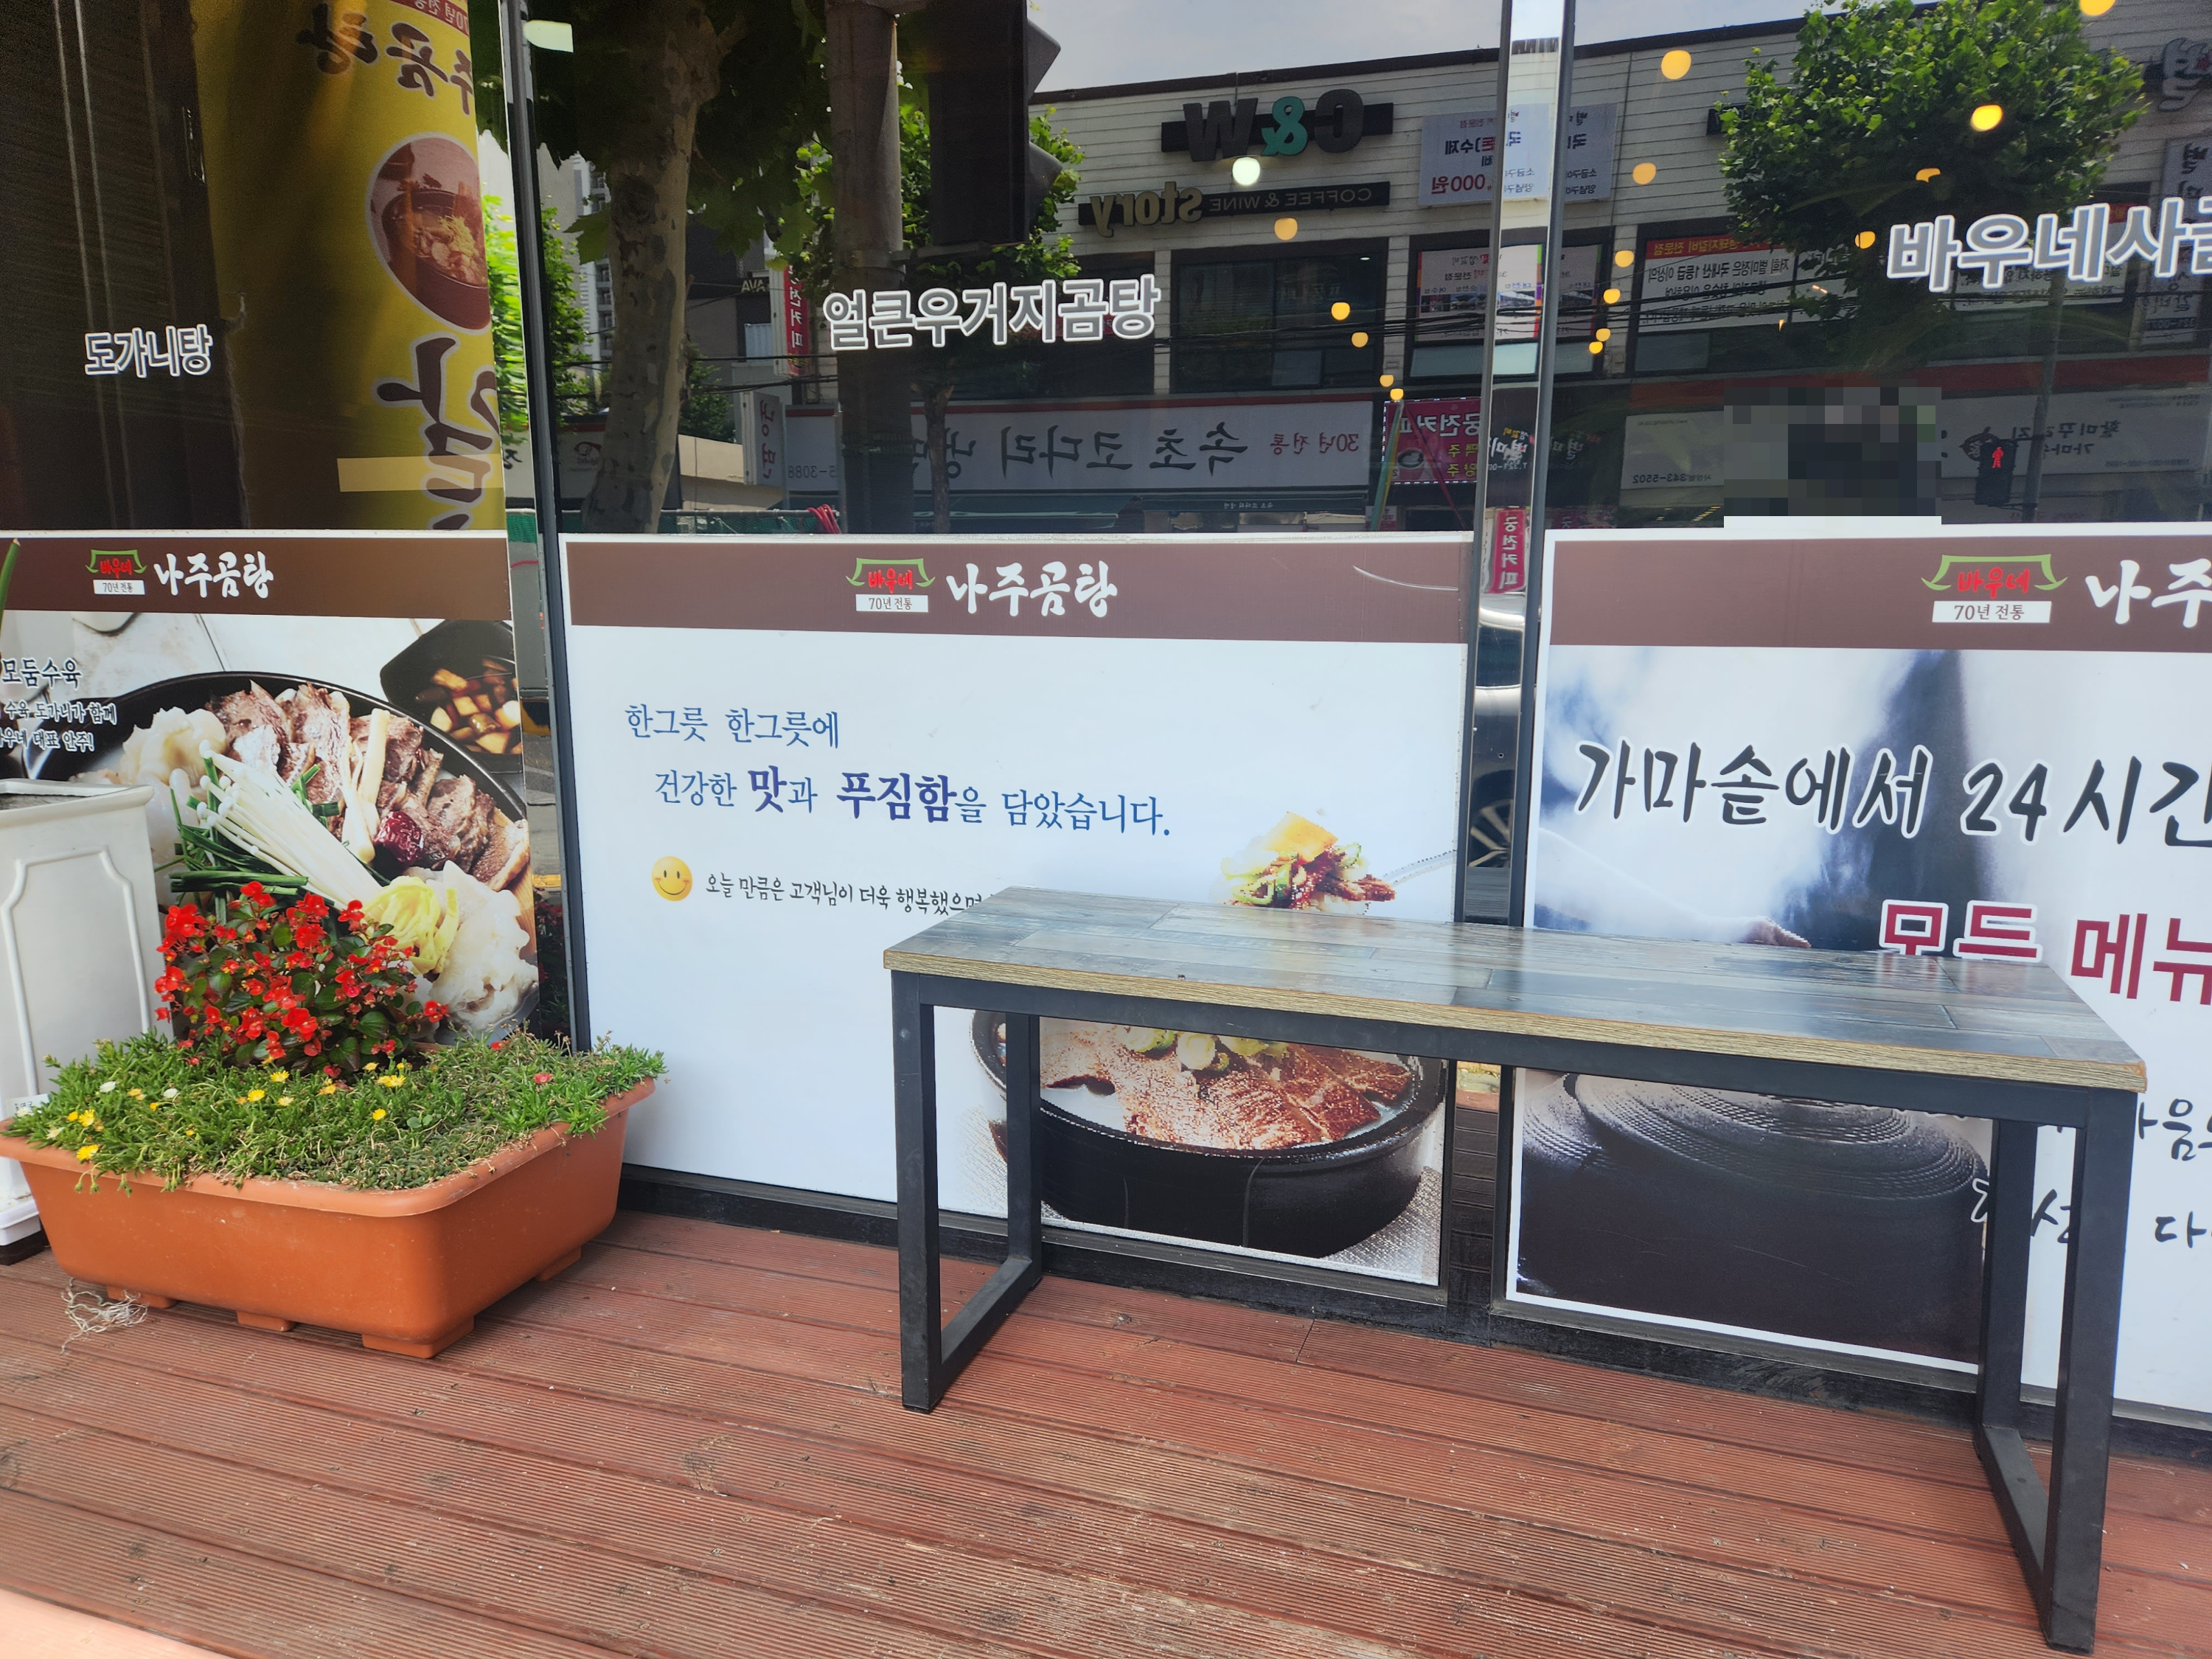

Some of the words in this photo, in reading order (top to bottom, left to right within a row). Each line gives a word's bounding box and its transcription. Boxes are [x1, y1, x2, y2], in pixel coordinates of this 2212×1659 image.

[822, 274, 1162, 352] 얼큰우거지곰탕
[84, 324, 213, 378] 도가니탕
[100, 557, 132, 579] 바우네
[153, 550, 274, 599] 나주곰탕
[867, 567, 914, 594] 바우네
[1958, 567, 2031, 599] 바우네
[102, 582, 119, 594] 70년
[868, 597, 893, 611] 70년
[894, 597, 914, 611] 전통
[945, 560, 1118, 618] 나주곰탕
[1954, 604, 1990, 620] 70년
[1994, 603, 2025, 620] 전통
[1, 658, 83, 690] 모둠수육
[34, 701, 86, 723] 도가니가
[86, 701, 118, 725] 함께
[624, 703, 709, 742] 한그릇
[724, 707, 839, 749] 한그릇에
[32, 728, 61, 751] 대표
[62, 730, 95, 753] 안주!
[655, 769, 738, 807] 건강한
[747, 765, 818, 814] 맛과
[837, 771, 987, 824] 푸짐함을
[1001, 788, 1170, 836] 담았습니다.
[1576, 740, 1929, 836] 가마솥에서
[706, 872, 734, 899] 오늘
[738, 875, 785, 901] 만큼은
[789, 880, 853, 906] 고객님이
[859, 885, 891, 910] 더욱
